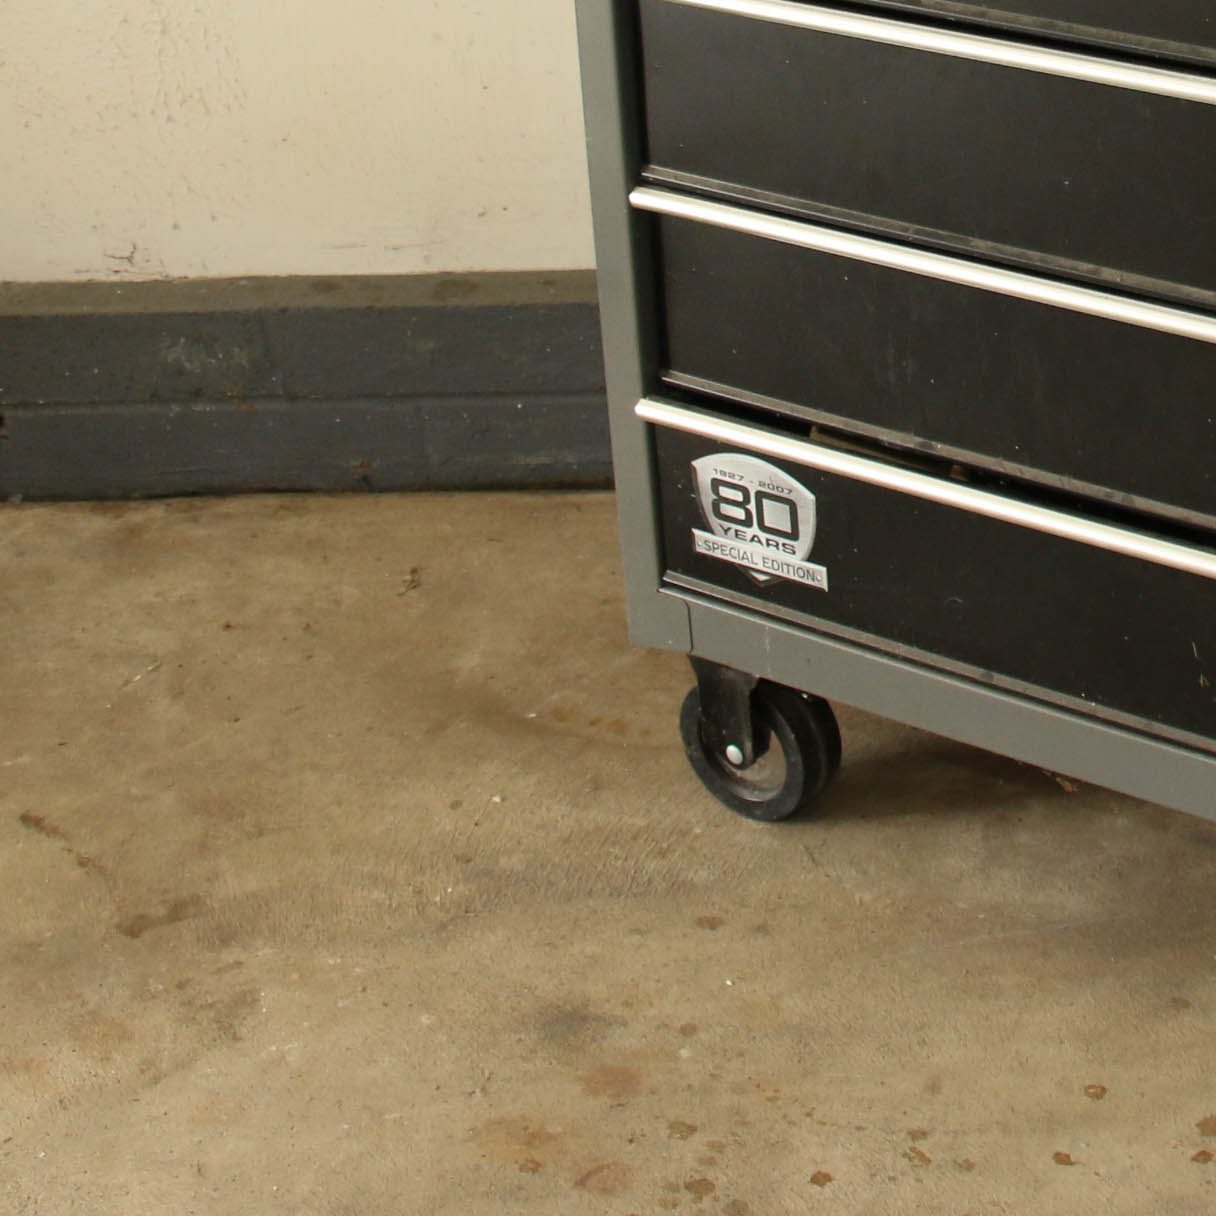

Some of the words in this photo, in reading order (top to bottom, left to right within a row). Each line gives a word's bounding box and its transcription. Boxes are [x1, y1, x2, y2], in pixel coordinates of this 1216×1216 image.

[713, 468, 745, 482] 1927
[758, 481, 793, 495] 2007
[710, 477, 800, 542] 80
[718, 524, 796, 555] YEARS
[704, 540, 759, 565] SPECIAL
[762, 556, 816, 582] EDITION
